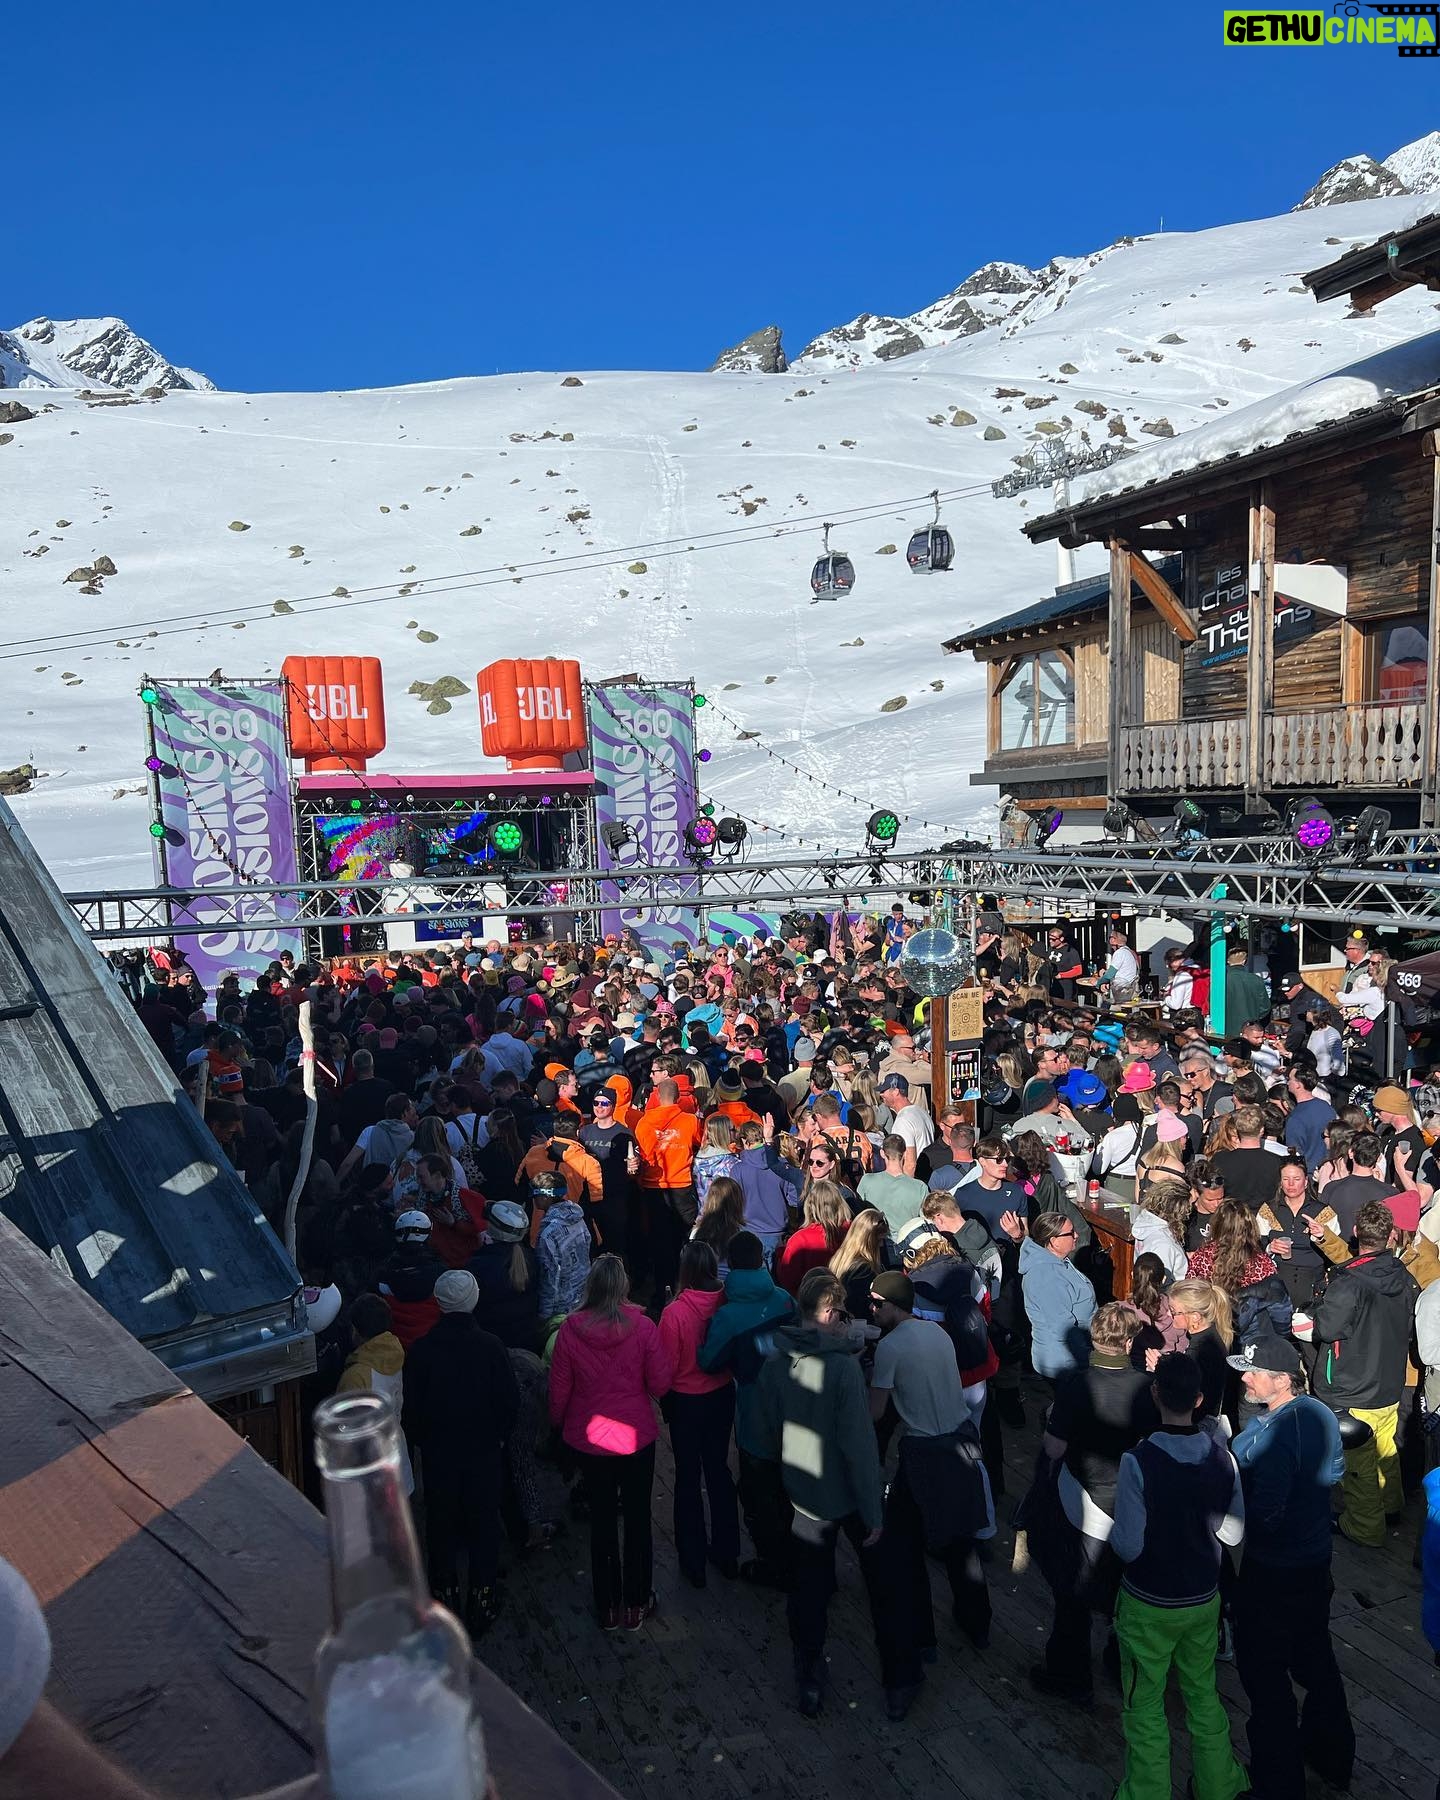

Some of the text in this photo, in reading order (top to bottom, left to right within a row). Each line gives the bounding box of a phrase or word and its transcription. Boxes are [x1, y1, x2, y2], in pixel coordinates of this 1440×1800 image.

[1217, 565, 1242, 585] les
[1201, 605, 1312, 653] Thons
[305, 684, 368, 721] JBL
[515, 687, 572, 721] JBL
[181, 708, 258, 743] 360
[612, 708, 673, 740] 360
[182, 749, 240, 957] CLOSING
[952, 991, 980, 1000] SCAN ME
[1396, 972, 1422, 988] 360
